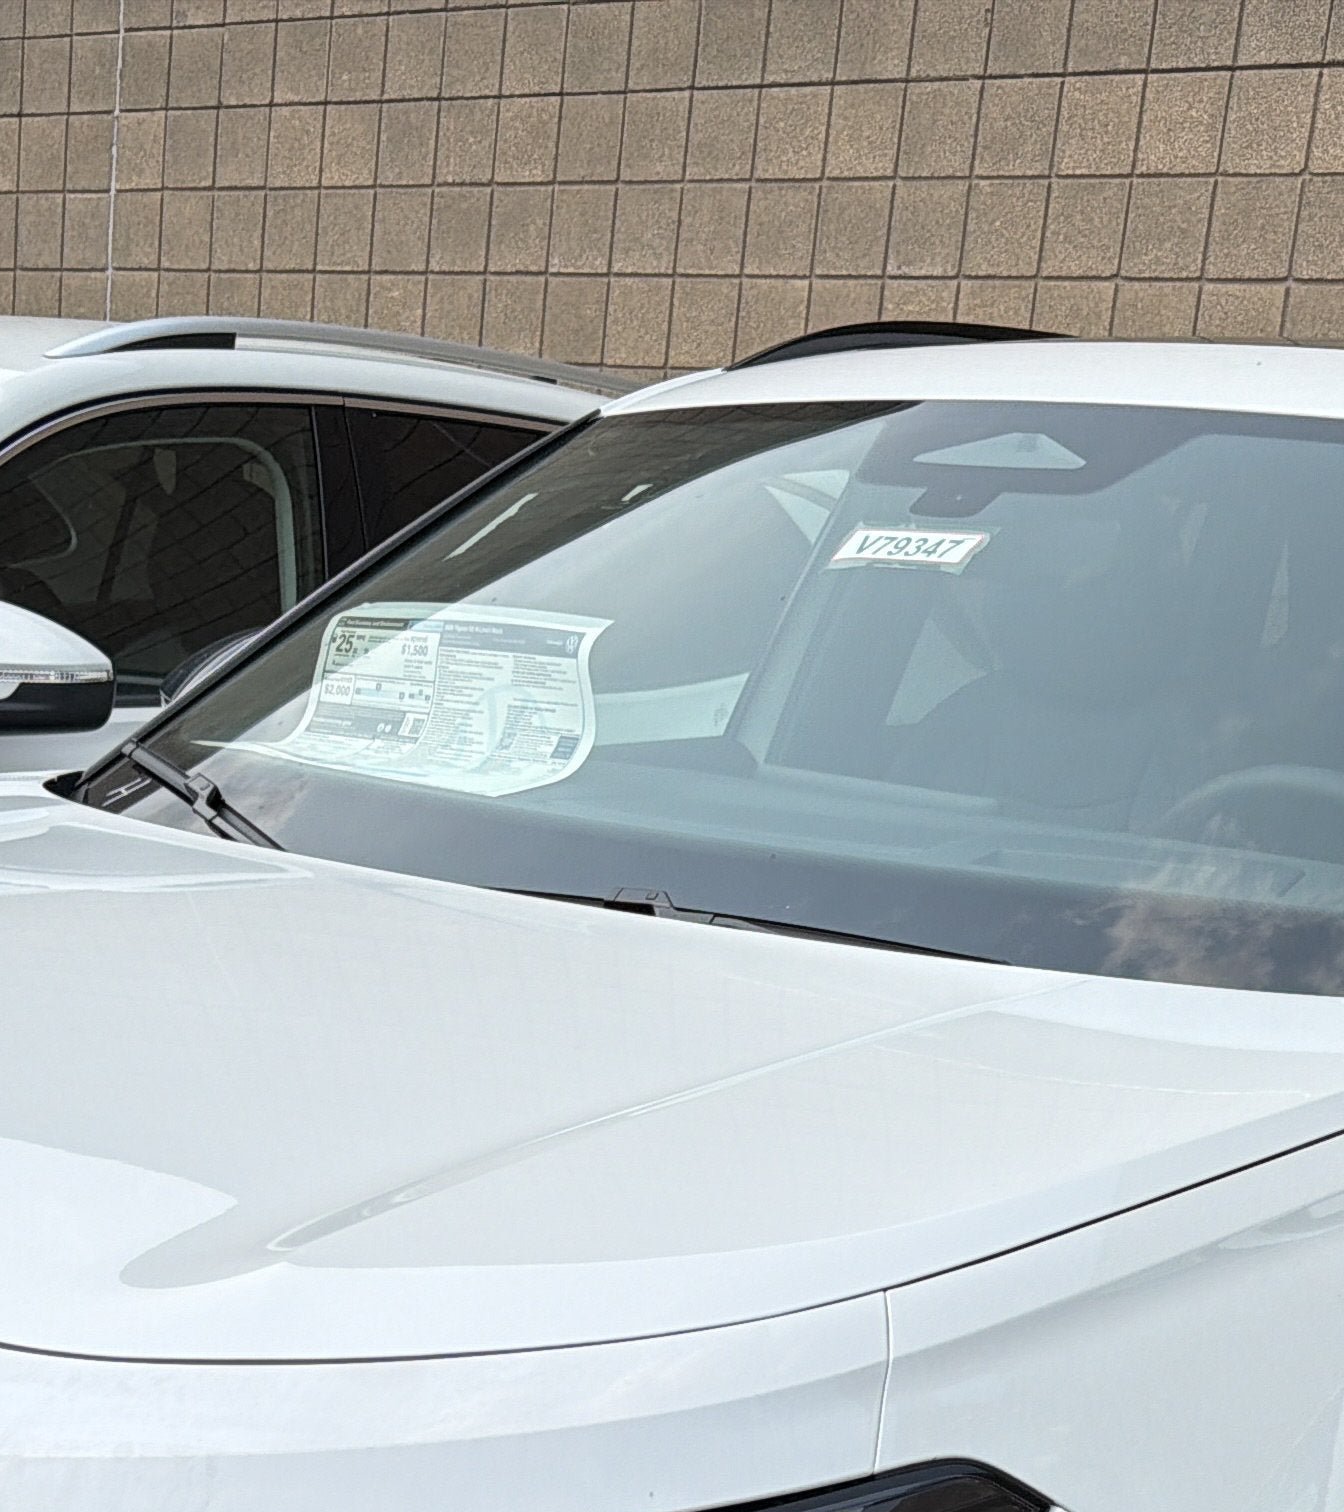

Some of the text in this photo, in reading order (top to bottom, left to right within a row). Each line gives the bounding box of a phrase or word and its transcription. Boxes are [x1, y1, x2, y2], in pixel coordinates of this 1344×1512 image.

[855, 535, 965, 559] V79347
[335, 633, 355, 653] 25
[401, 644, 428, 657] $1,500
[324, 683, 350, 697] $2,000
